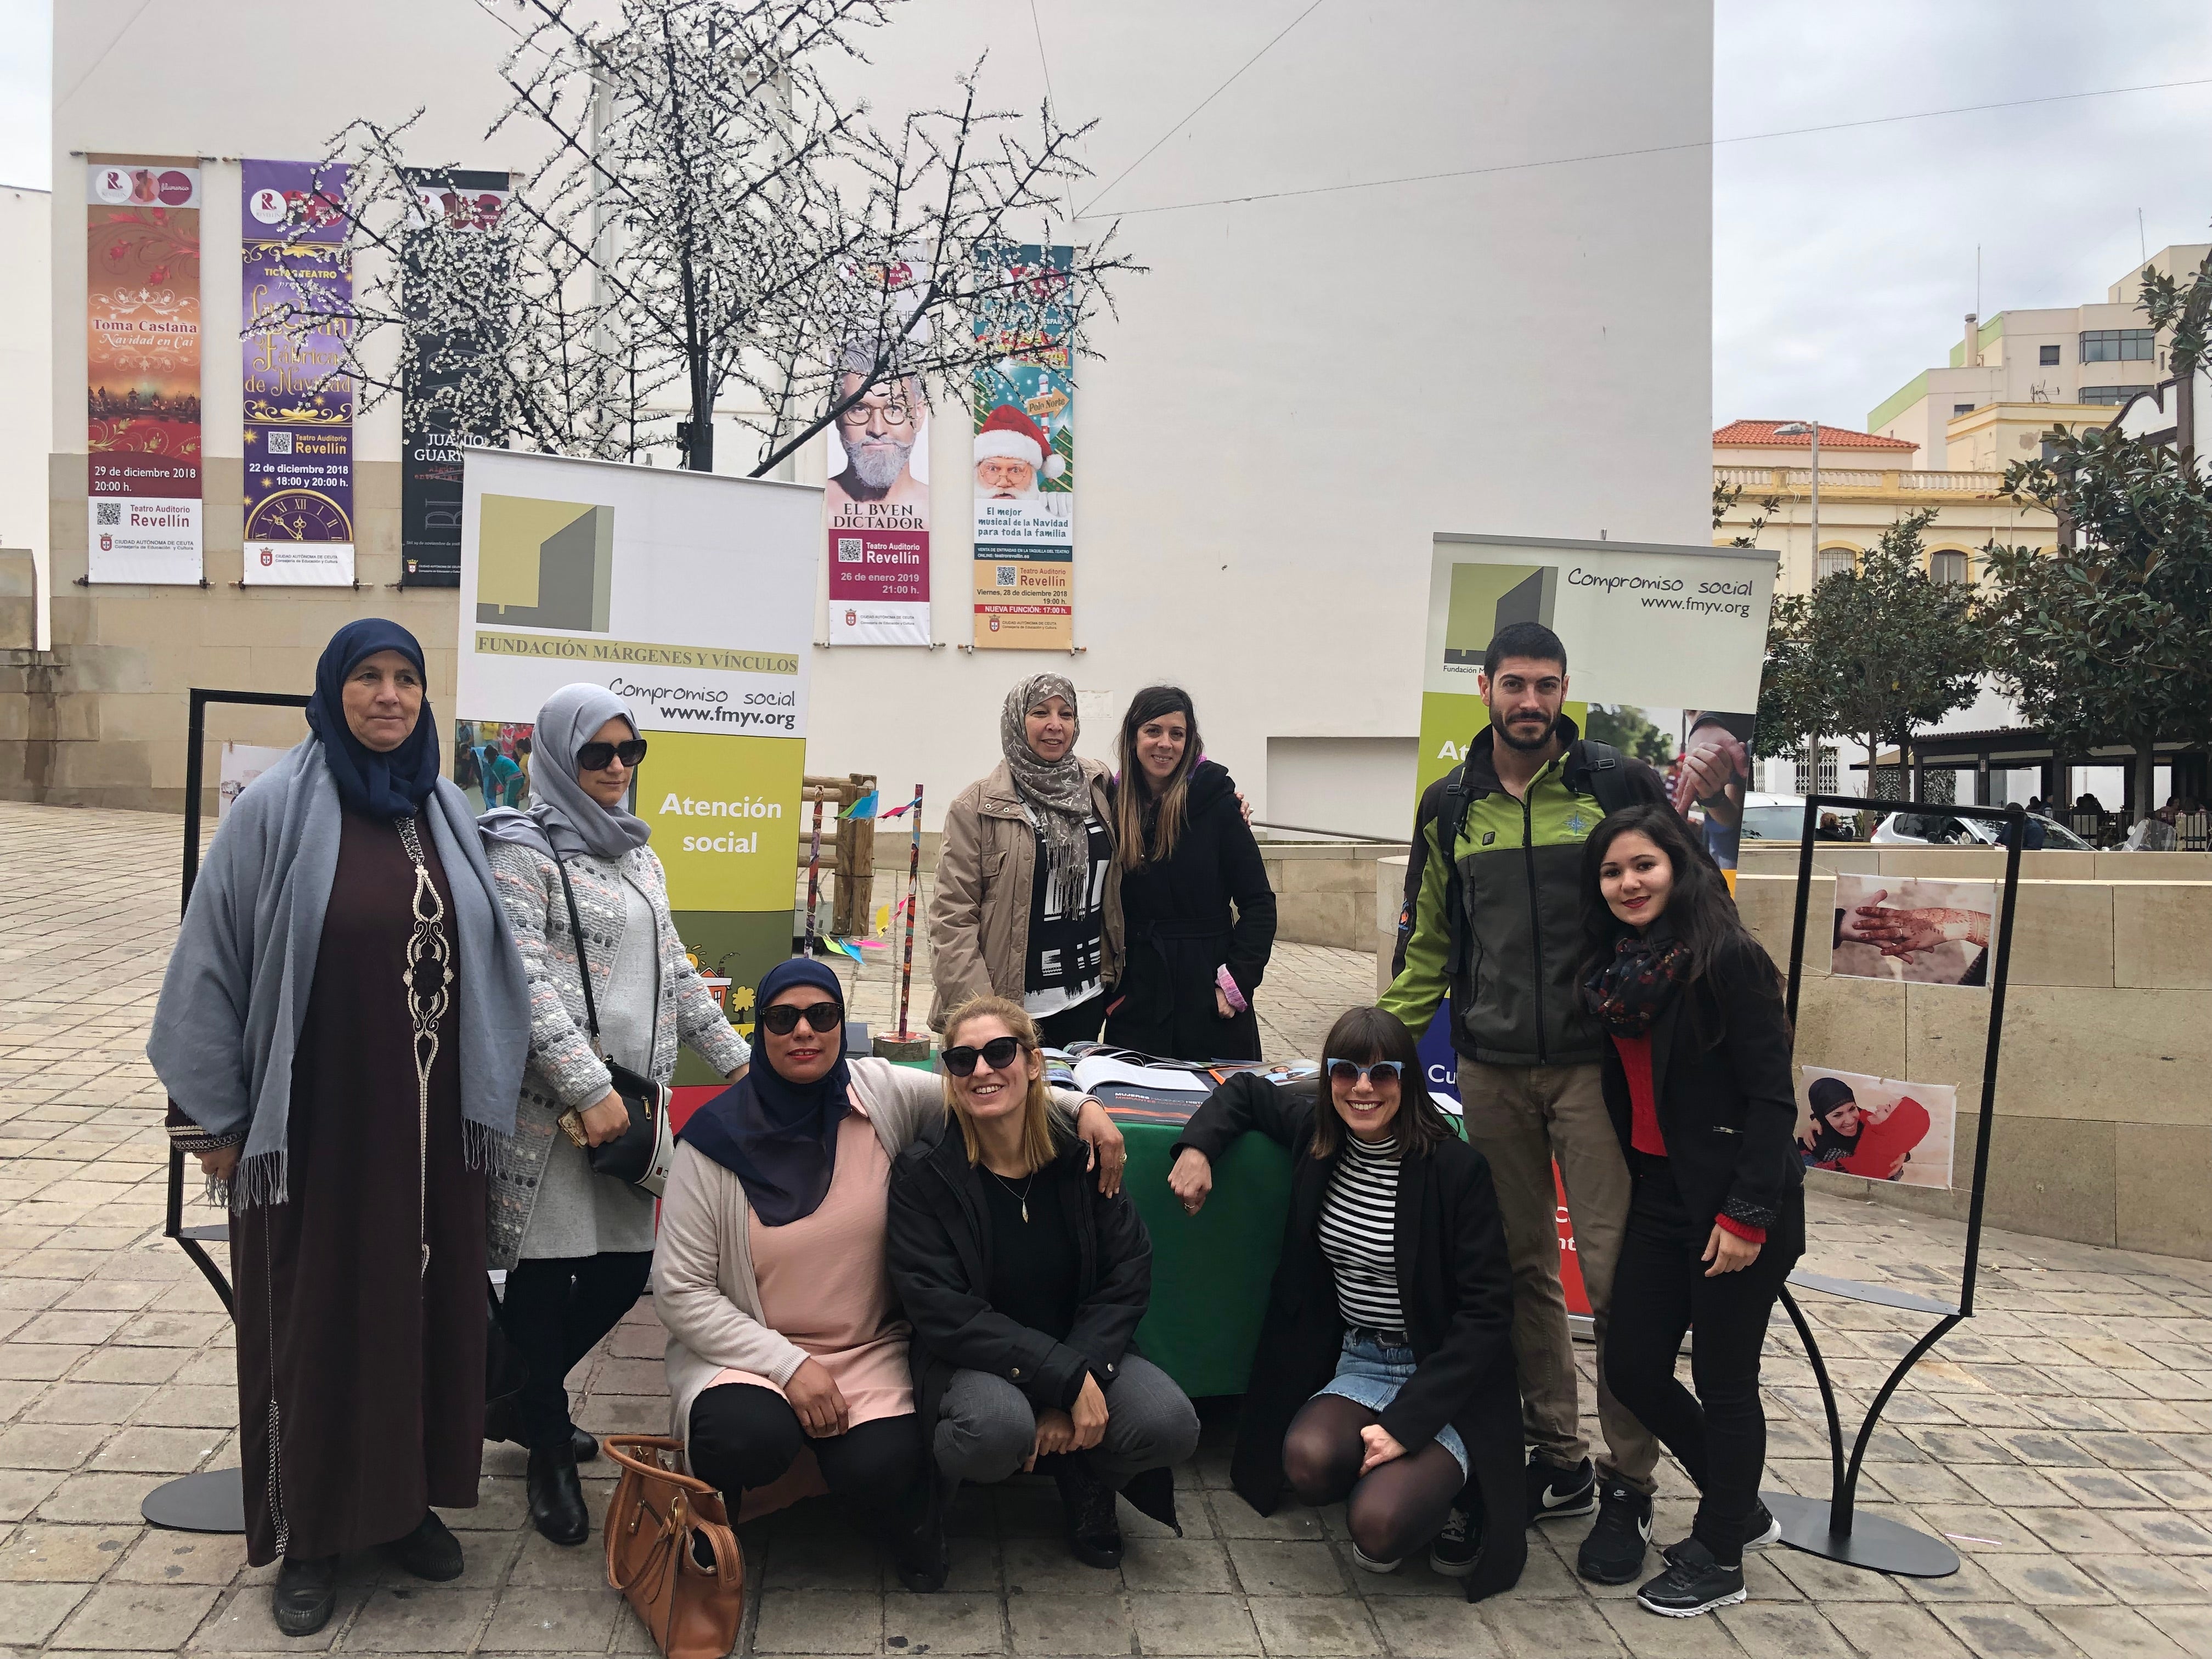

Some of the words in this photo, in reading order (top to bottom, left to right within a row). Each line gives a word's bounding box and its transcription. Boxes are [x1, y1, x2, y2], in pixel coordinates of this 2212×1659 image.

[300, 270, 337, 279] TEATRO
[94, 319, 133, 331] Toma
[139, 320, 197, 333] Castaña
[99, 334, 153, 347] Navidad
[174, 336, 193, 349] Cai
[245, 375, 265, 392] de
[1029, 403, 1044, 411] Polo
[1046, 398, 1065, 408] Norte
[296, 442, 346, 454] Revellín
[414, 449, 464, 461] GUARN
[94, 466, 106, 476] 29
[109, 467, 121, 477] de
[124, 467, 170, 478] diciembre
[173, 468, 196, 478] 2018
[249, 464, 261, 472] 22
[263, 464, 275, 473] de
[277, 464, 324, 473] diciembre
[326, 465, 348, 474] 2018
[94, 481, 120, 492] 20:00
[123, 482, 132, 492] h.
[276, 477, 302, 486] 18:00
[304, 478, 309, 488] y
[312, 478, 337, 487] 20:00
[340, 478, 348, 487] h.
[844, 503, 862, 515] EL
[869, 504, 913, 516] BVEN
[987, 507, 994, 515] El
[997, 508, 1022, 517] mejor
[131, 514, 189, 527] Revellín
[834, 516, 924, 529] DICTADOR
[1033, 518, 1068, 527] Navidad
[978, 529, 998, 537] para
[1024, 528, 1032, 537] la
[1035, 529, 1066, 538] familia
[867, 551, 919, 564] Revellín
[841, 572, 852, 581] 26
[855, 573, 866, 581] de
[898, 574, 919, 582] 2019
[1020, 575, 1065, 586] Revellín
[1567, 567, 1684, 594] Compromiso
[1698, 579, 1753, 596] social
[882, 585, 908, 594] 21:00
[910, 585, 919, 594] h.
[1009, 605, 1042, 613] FUNCIÓN:
[1641, 596, 1750, 618] www.fmyv.org
[478, 636, 588, 658] FUNDACIÓN
[592, 642, 692, 666] MÁRGENES
[696, 652, 709, 667] Y
[712, 651, 798, 673] VÍNCULOS
[1443, 665, 1476, 674] Fundación
[610, 678, 728, 706] Compromiso
[743, 691, 795, 707] social
[660, 704, 795, 730] www.fmyv.org
[1437, 741, 1470, 761] At
[658, 793, 782, 819] Atención
[682, 831, 757, 853] social
[1427, 1064, 1457, 1084] Cu
